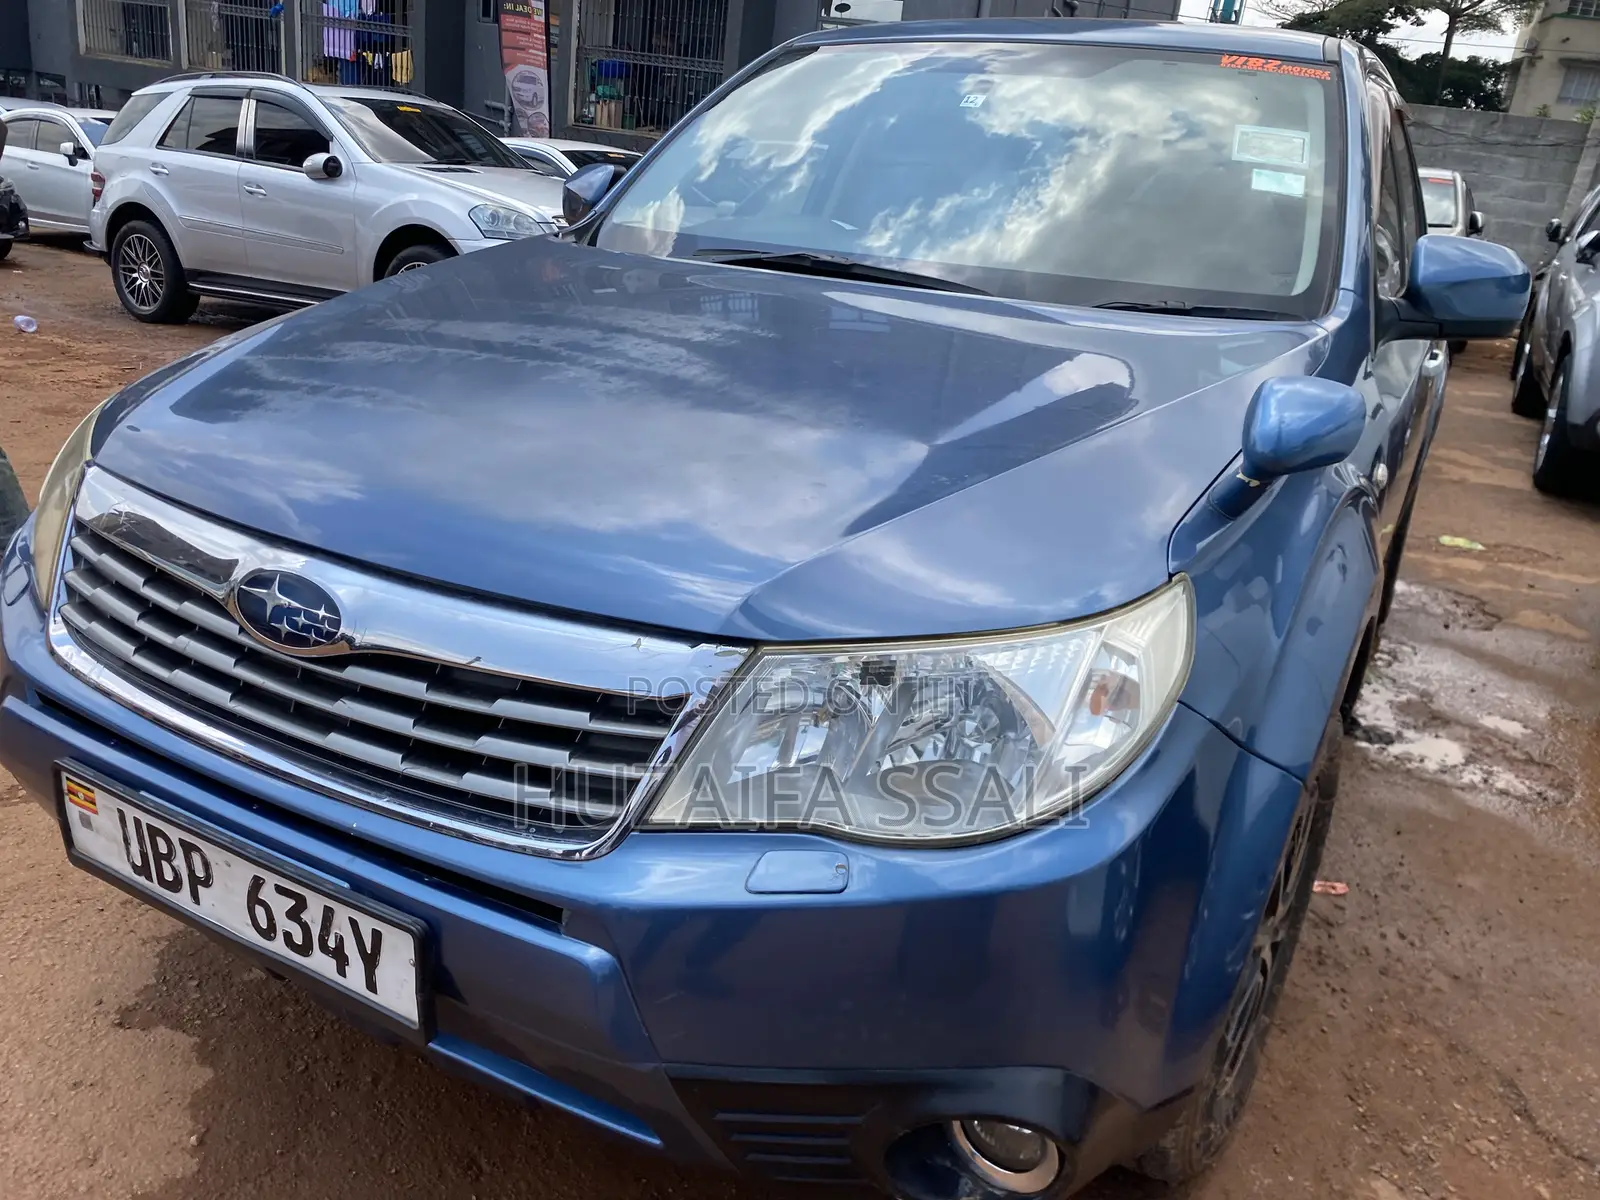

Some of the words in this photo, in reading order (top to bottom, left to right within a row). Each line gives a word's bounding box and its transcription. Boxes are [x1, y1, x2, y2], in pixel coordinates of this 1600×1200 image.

[1221, 54, 1282, 71] VIBZ
[1280, 65, 1331, 77] MOTORS
[116, 806, 214, 906] UBP
[246, 874, 383, 995] 634Y
